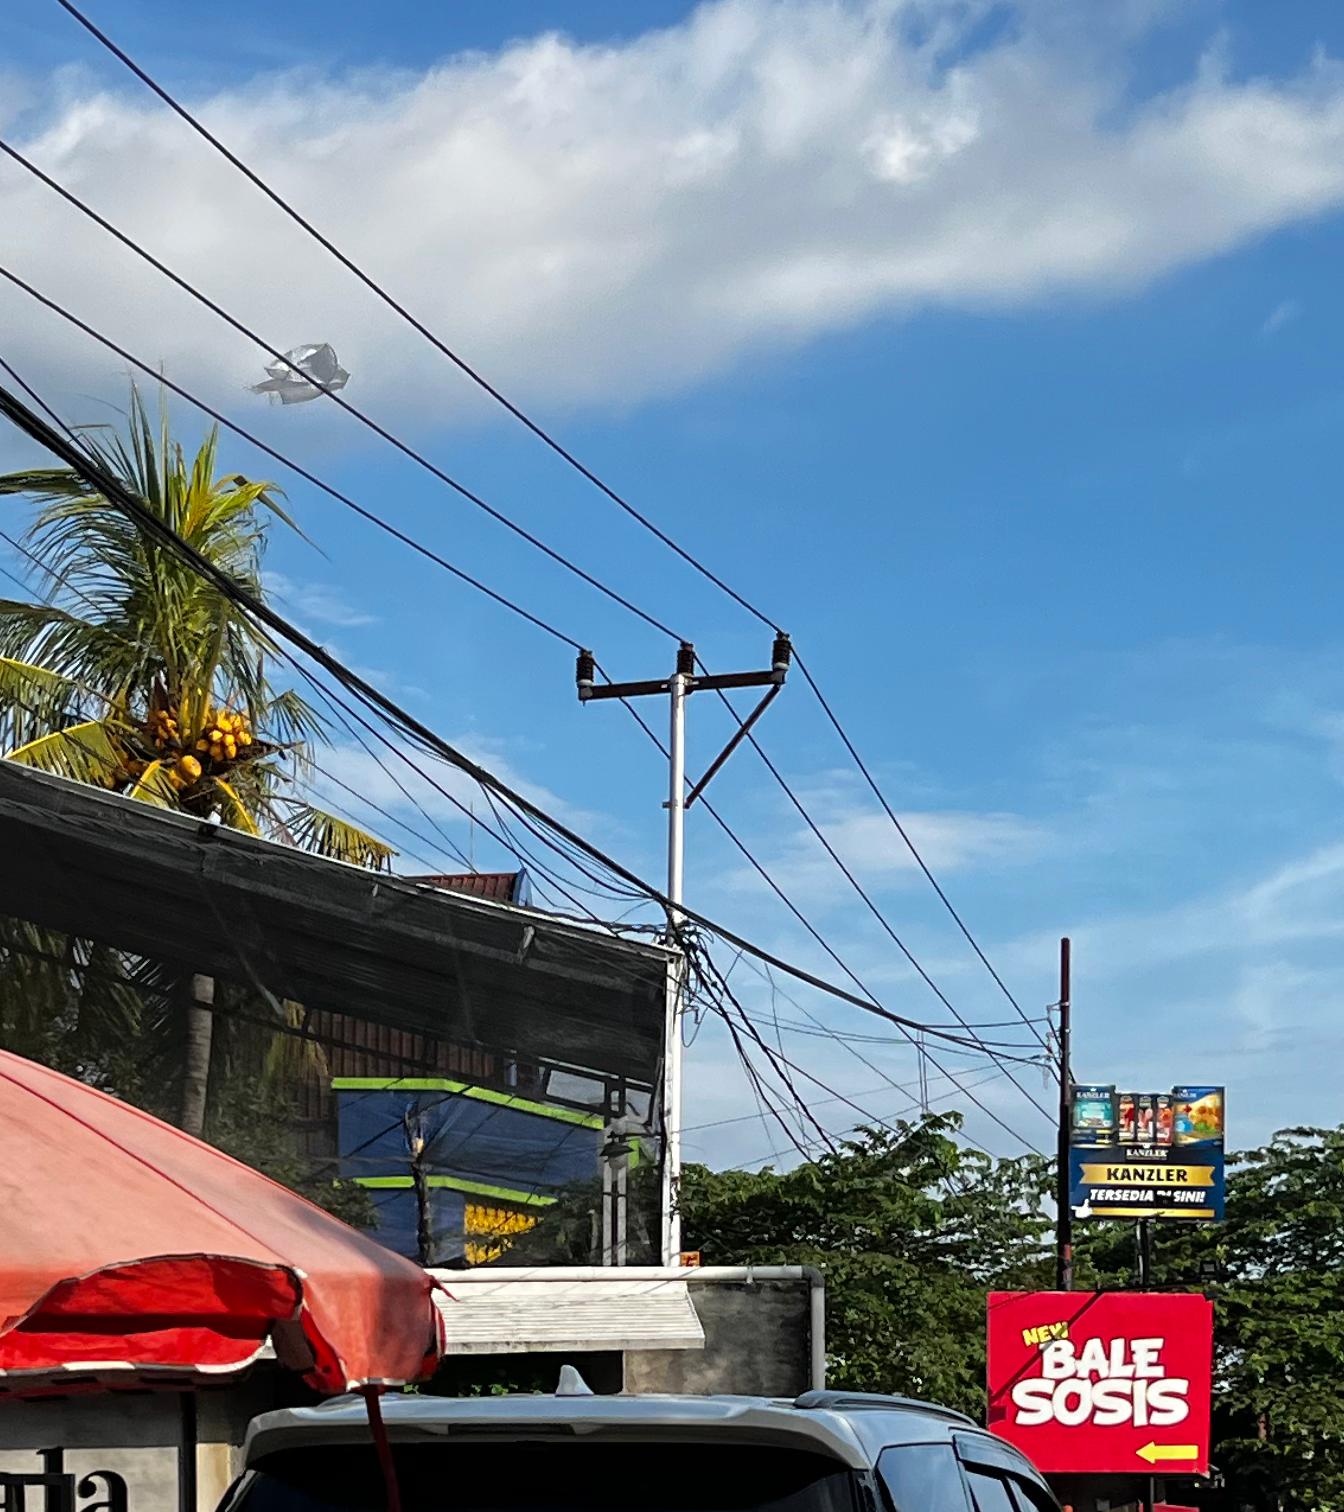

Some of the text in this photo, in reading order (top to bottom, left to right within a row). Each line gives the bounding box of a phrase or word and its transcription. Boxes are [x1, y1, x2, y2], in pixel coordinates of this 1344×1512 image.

[1126, 1149, 1169, 1158] KANZLER
[1106, 1167, 1188, 1182] KANZLER
[1090, 1188, 1154, 1202] TERSEDIA
[1173, 1190, 1206, 1204] SINI!
[1022, 1321, 1069, 1347] NEW
[1039, 1337, 1165, 1379] BALE
[1011, 1377, 1189, 1427] SOSIS
